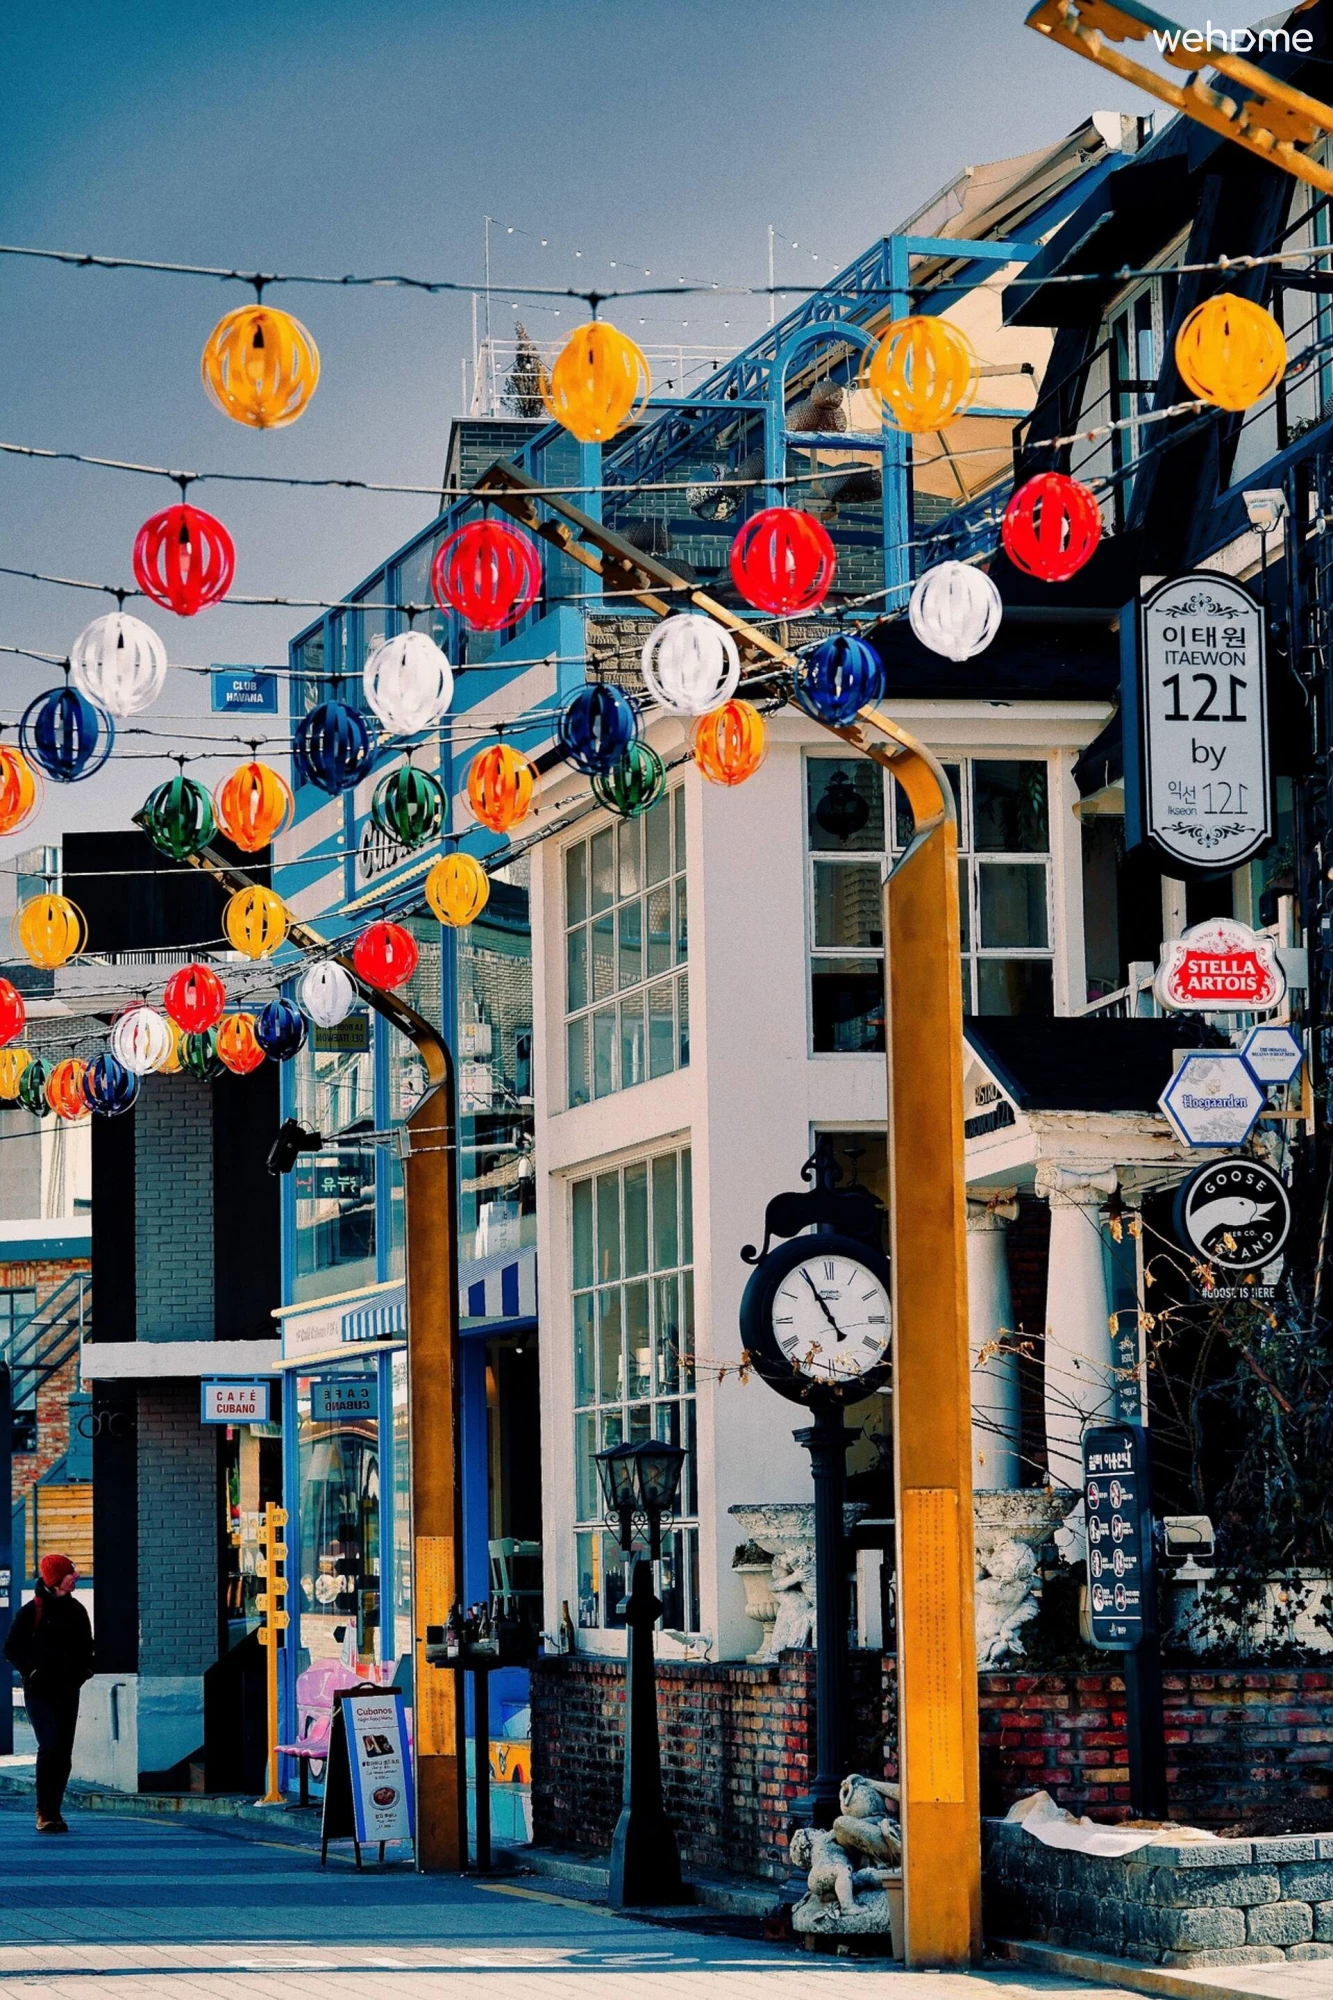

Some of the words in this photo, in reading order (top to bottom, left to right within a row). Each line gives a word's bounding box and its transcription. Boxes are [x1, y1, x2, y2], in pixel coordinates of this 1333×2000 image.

[1162, 626, 1246, 649] 이태원
[1165, 650, 1246, 666] ITAEWON
[233, 681, 257, 691] CLUB
[226, 692, 264, 703] HAVANA
[1162, 673, 1247, 722] 121
[1191, 738, 1226, 771] by
[1168, 781, 1196, 804] 익선
[1202, 781, 1248, 815] 121
[1188, 960, 1256, 974] STELLA
[1188, 976, 1257, 990] ARTOIS
[1182, 1094, 1248, 1111] Hoegaarden
[1204, 1170, 1267, 1194] GOOSE
[1239, 1287, 1249, 1298] IS
[216, 1389, 256, 1401] CAFÉ
[216, 1404, 256, 1414] CUBANO
[357, 1707, 393, 1716] Cubanos
